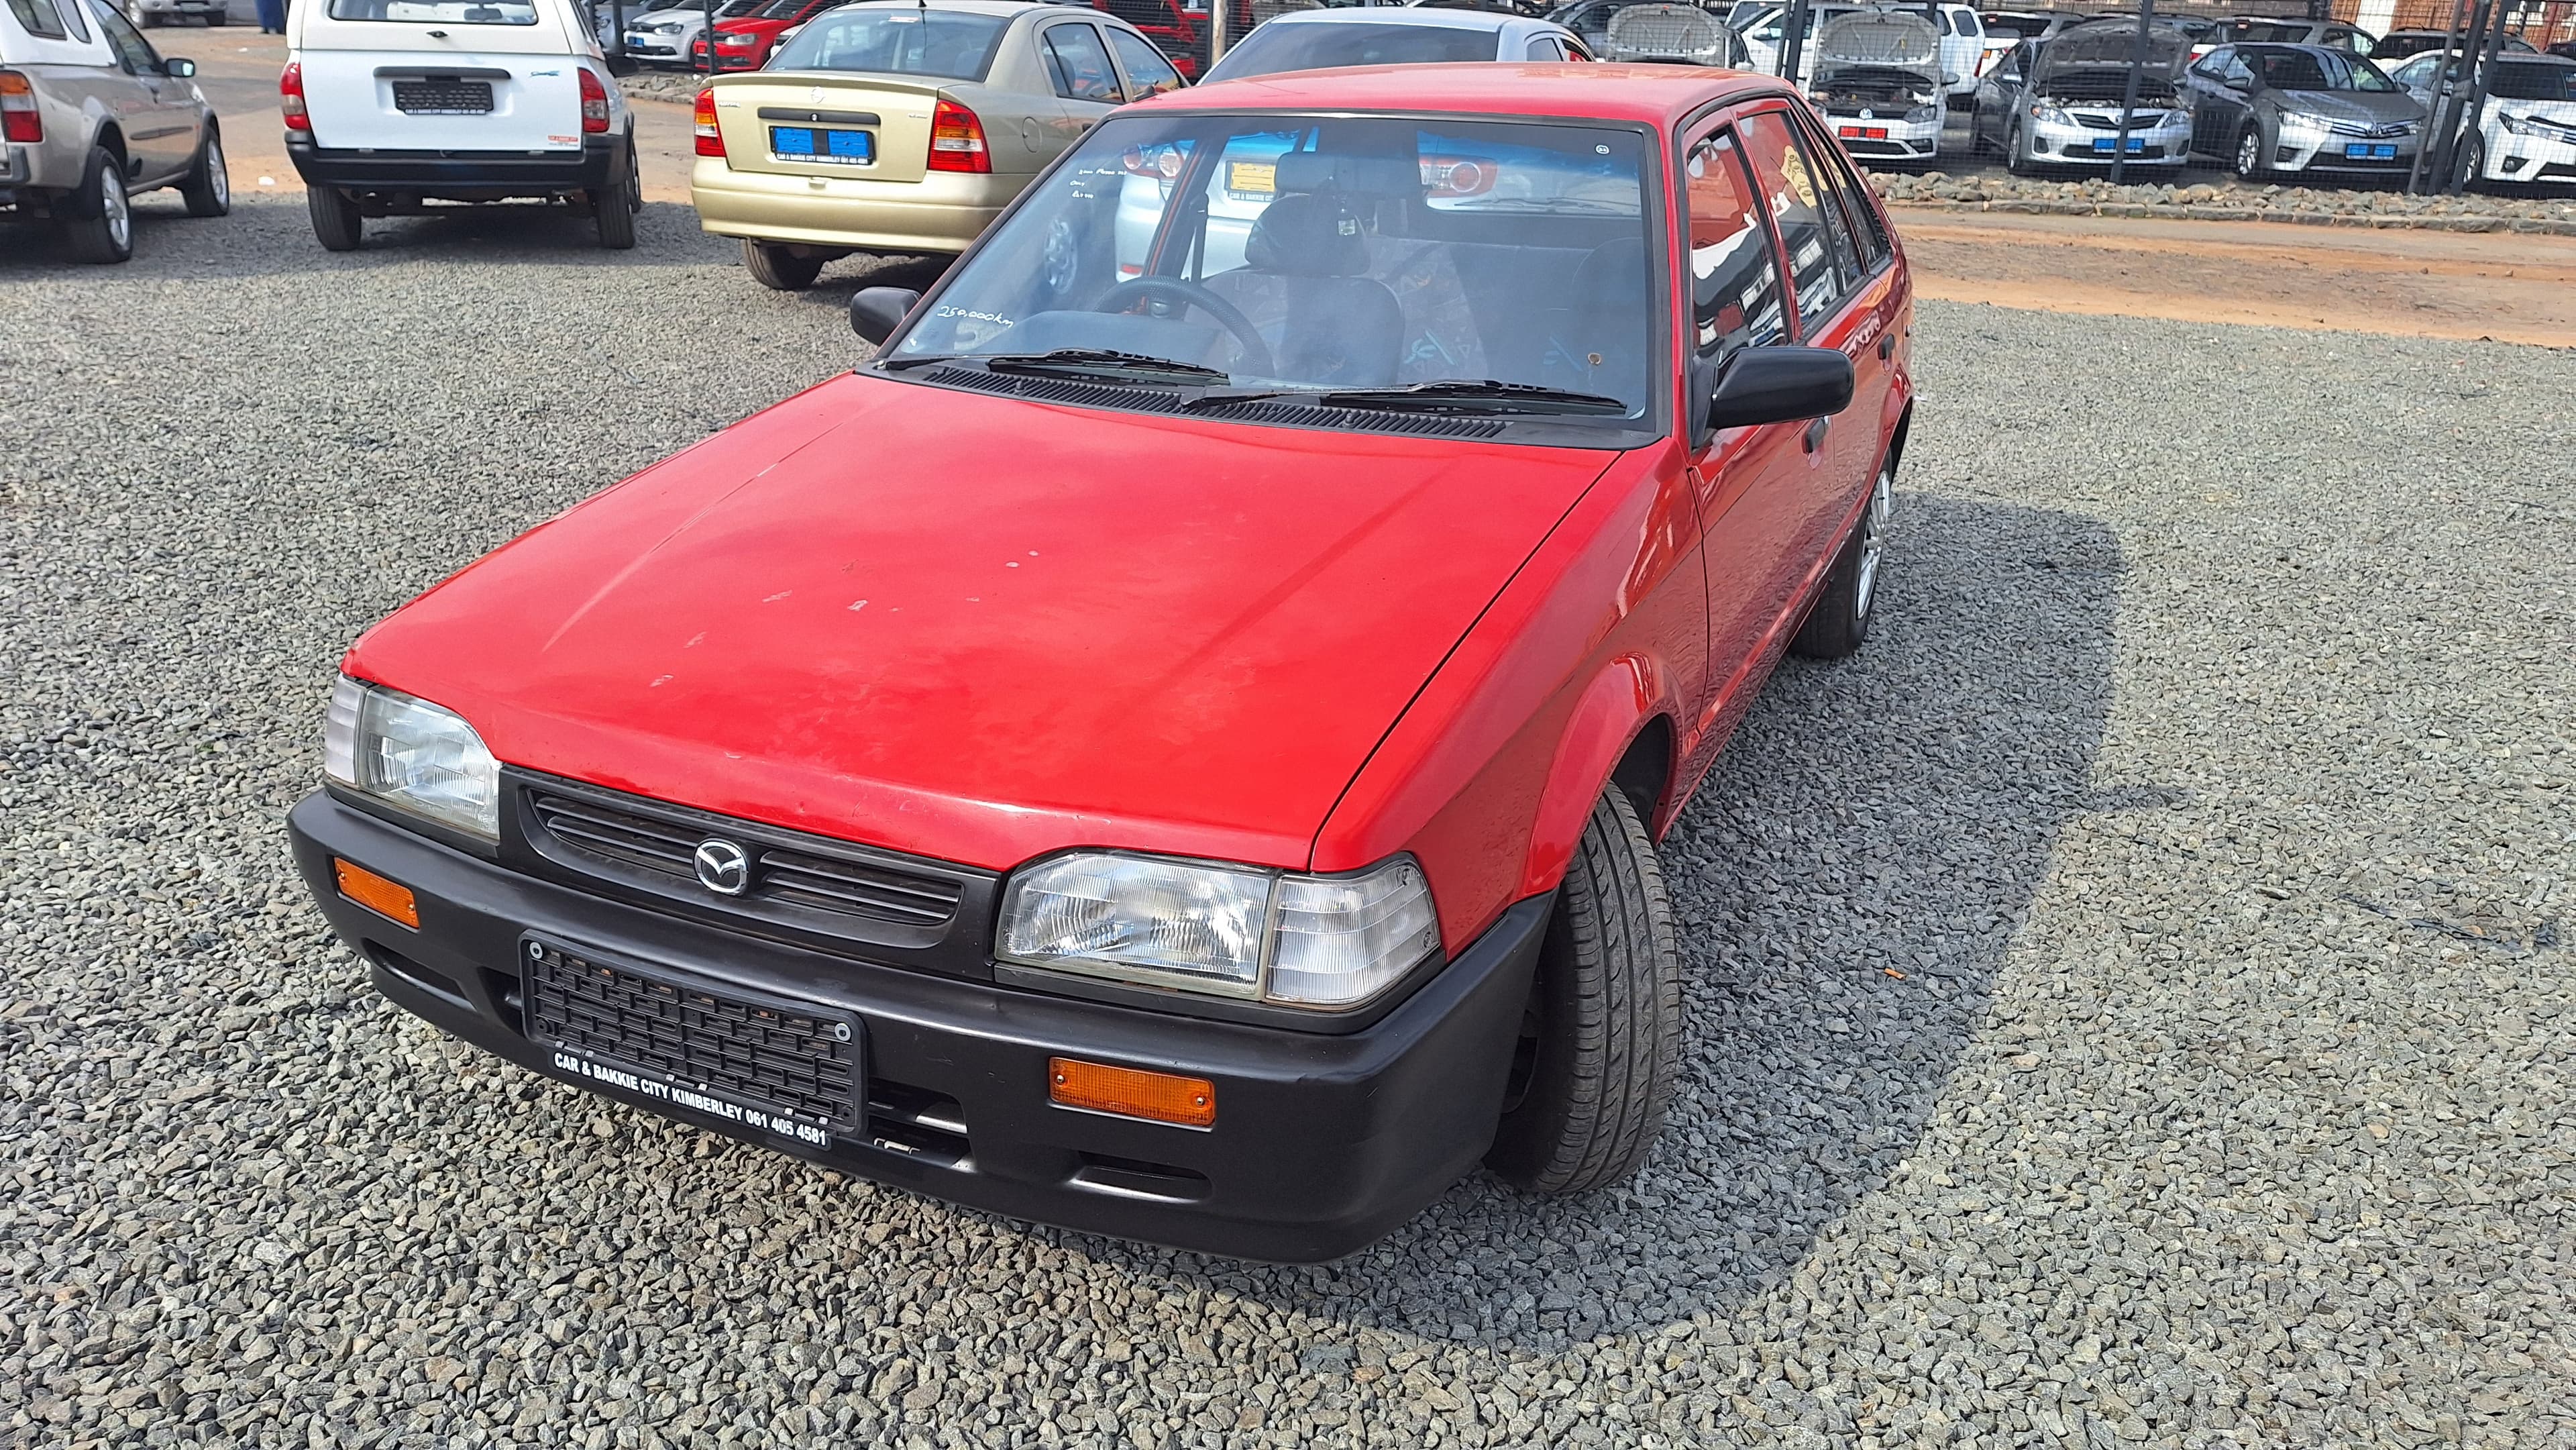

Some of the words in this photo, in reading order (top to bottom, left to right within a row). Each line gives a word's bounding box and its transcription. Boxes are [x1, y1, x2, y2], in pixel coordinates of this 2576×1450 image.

[554, 1053, 580, 1073] CAR
[582, 1059, 591, 1076] &
[593, 1064, 639, 1091] BAKKIE
[640, 1078, 669, 1099] CITY
[671, 1087, 743, 1121] KIMBERLEY
[745, 1109, 768, 1129] 061
[771, 1117, 794, 1136] 405
[796, 1124, 826, 1146] 4581
